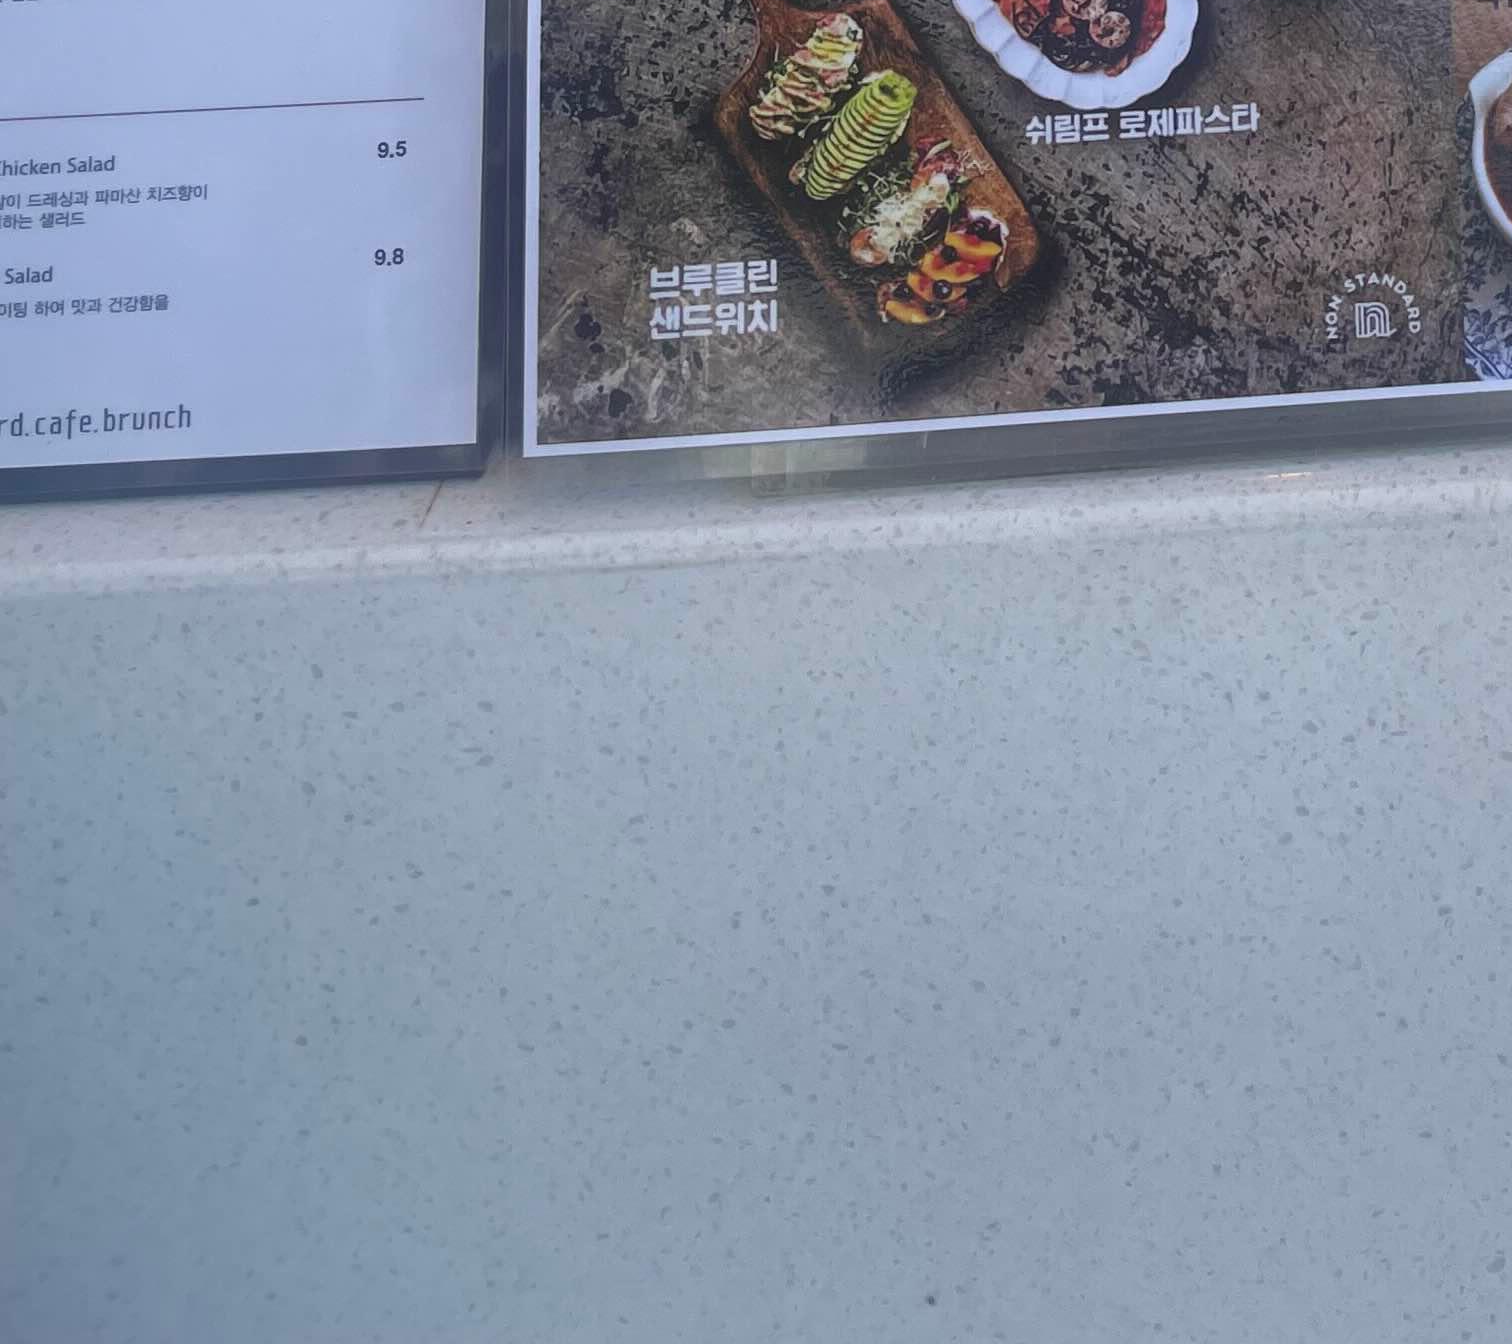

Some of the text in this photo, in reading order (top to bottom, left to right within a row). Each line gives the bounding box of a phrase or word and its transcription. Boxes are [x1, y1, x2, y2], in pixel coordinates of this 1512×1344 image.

[1025, 102, 1261, 144] 쉬림프 로제파스타
[67, 155, 116, 174] Salad
[376, 140, 408, 159] 9.5
[27, 190, 88, 208] 드레싱과
[95, 187, 141, 204] 파마산
[146, 184, 208, 202] 치즈향이
[4, 247, 405, 285] Salad 9.8
[649, 259, 778, 300] 브루클린
[34, 301, 65, 317] 하여
[71, 297, 102, 315] 맛과
[108, 294, 169, 313] 건강함을
[649, 299, 778, 340] 샌드위치
[1325, 272, 1421, 339] NON STANDARD
